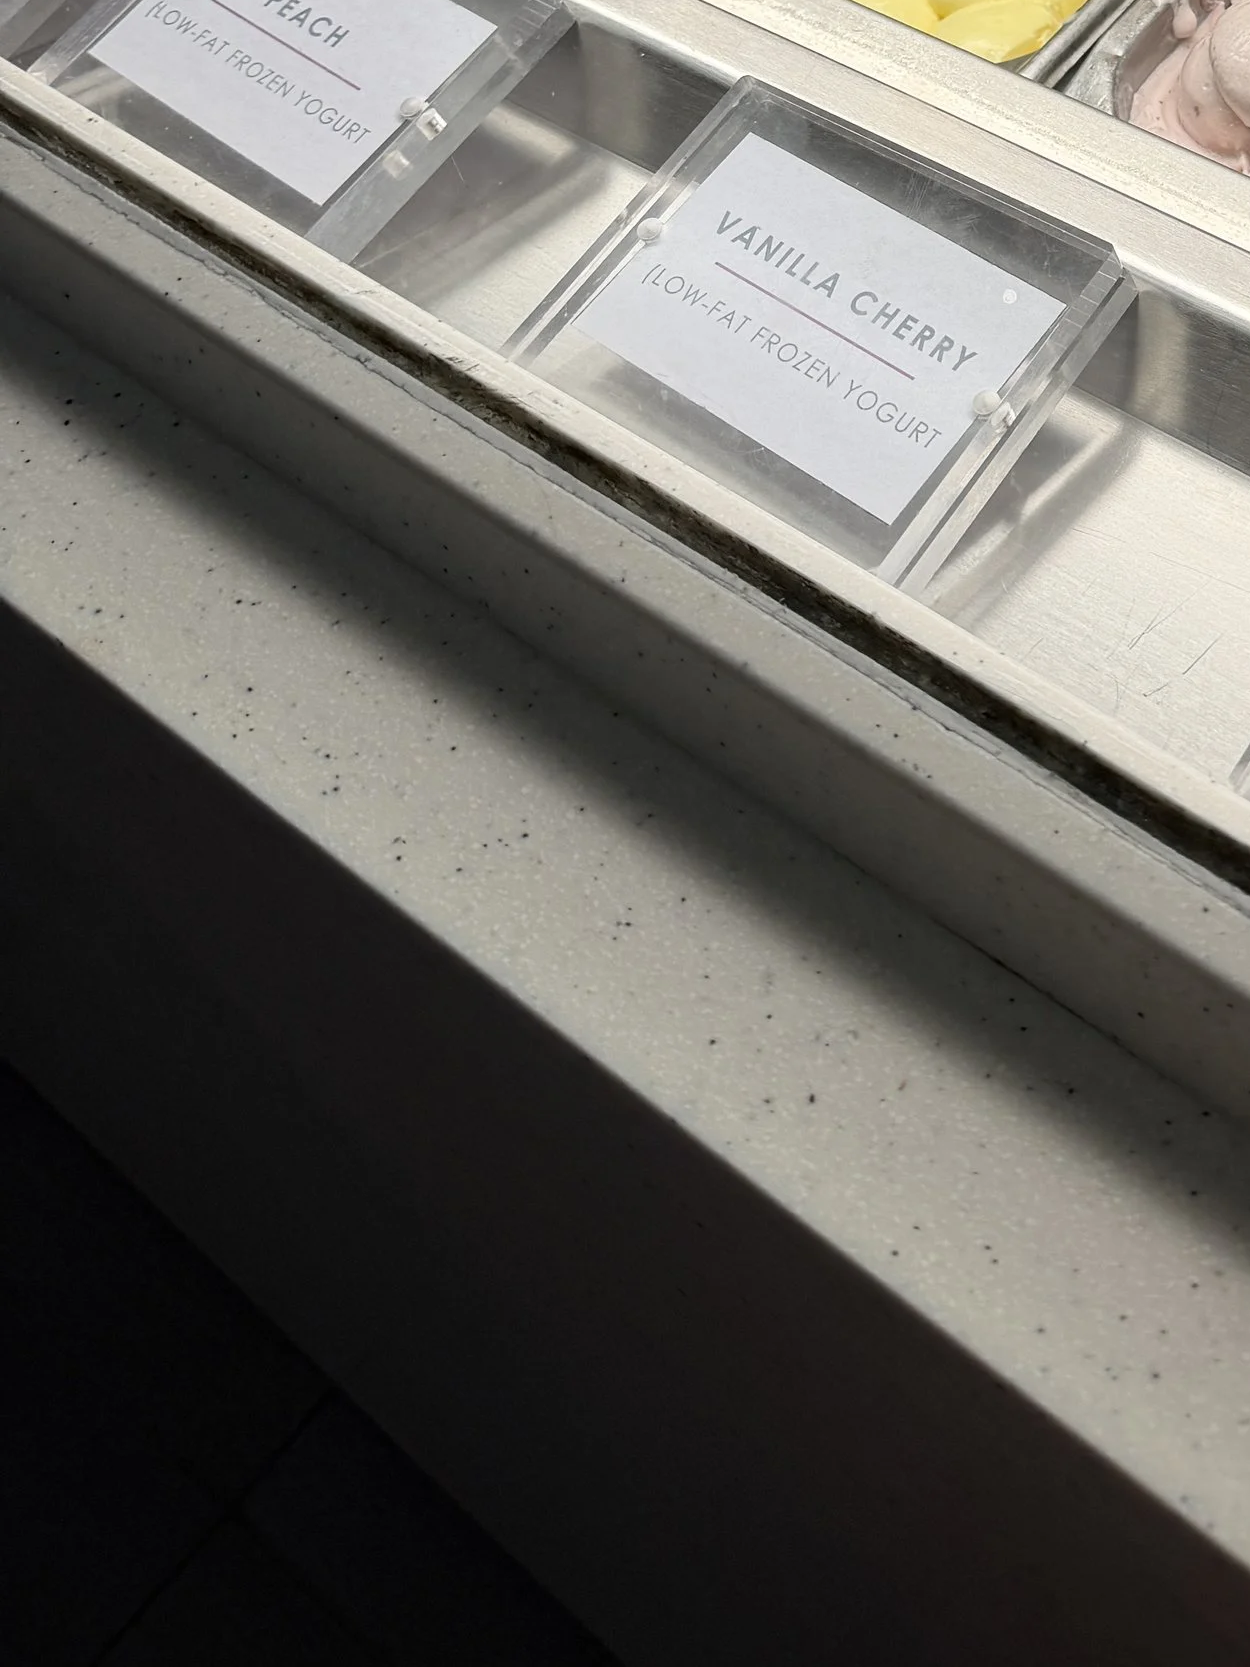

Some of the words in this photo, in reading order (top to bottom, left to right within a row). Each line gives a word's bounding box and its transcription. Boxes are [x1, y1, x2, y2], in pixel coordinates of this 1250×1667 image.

[225, 49, 296, 98] FROZEN
[294, 91, 372, 145] YOGURT
[641, 264, 752, 334] (LOW-FAT
[750, 326, 841, 389] FROZEN
[843, 379, 942, 448] YOGURT
[715, 211, 841, 298] VANILLA
[849, 291, 978, 372] CHERRY
